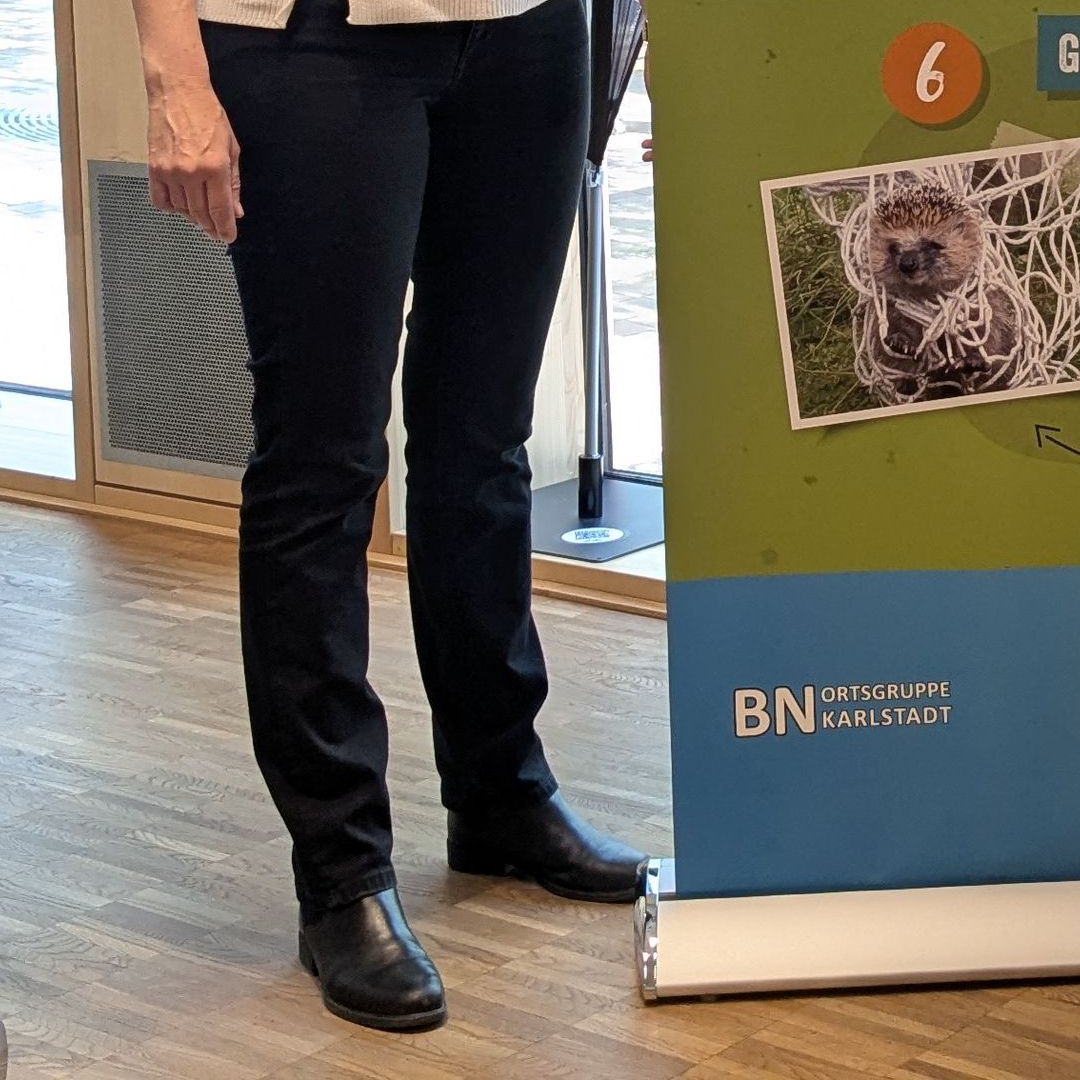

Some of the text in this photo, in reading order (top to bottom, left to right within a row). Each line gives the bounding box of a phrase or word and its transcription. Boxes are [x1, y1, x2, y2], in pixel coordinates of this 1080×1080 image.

[916, 41, 946, 102] 6
[821, 682, 950, 703] ORTSGRUPPE
[735, 686, 815, 737] BN
[823, 706, 951, 728] KARLSTADT
